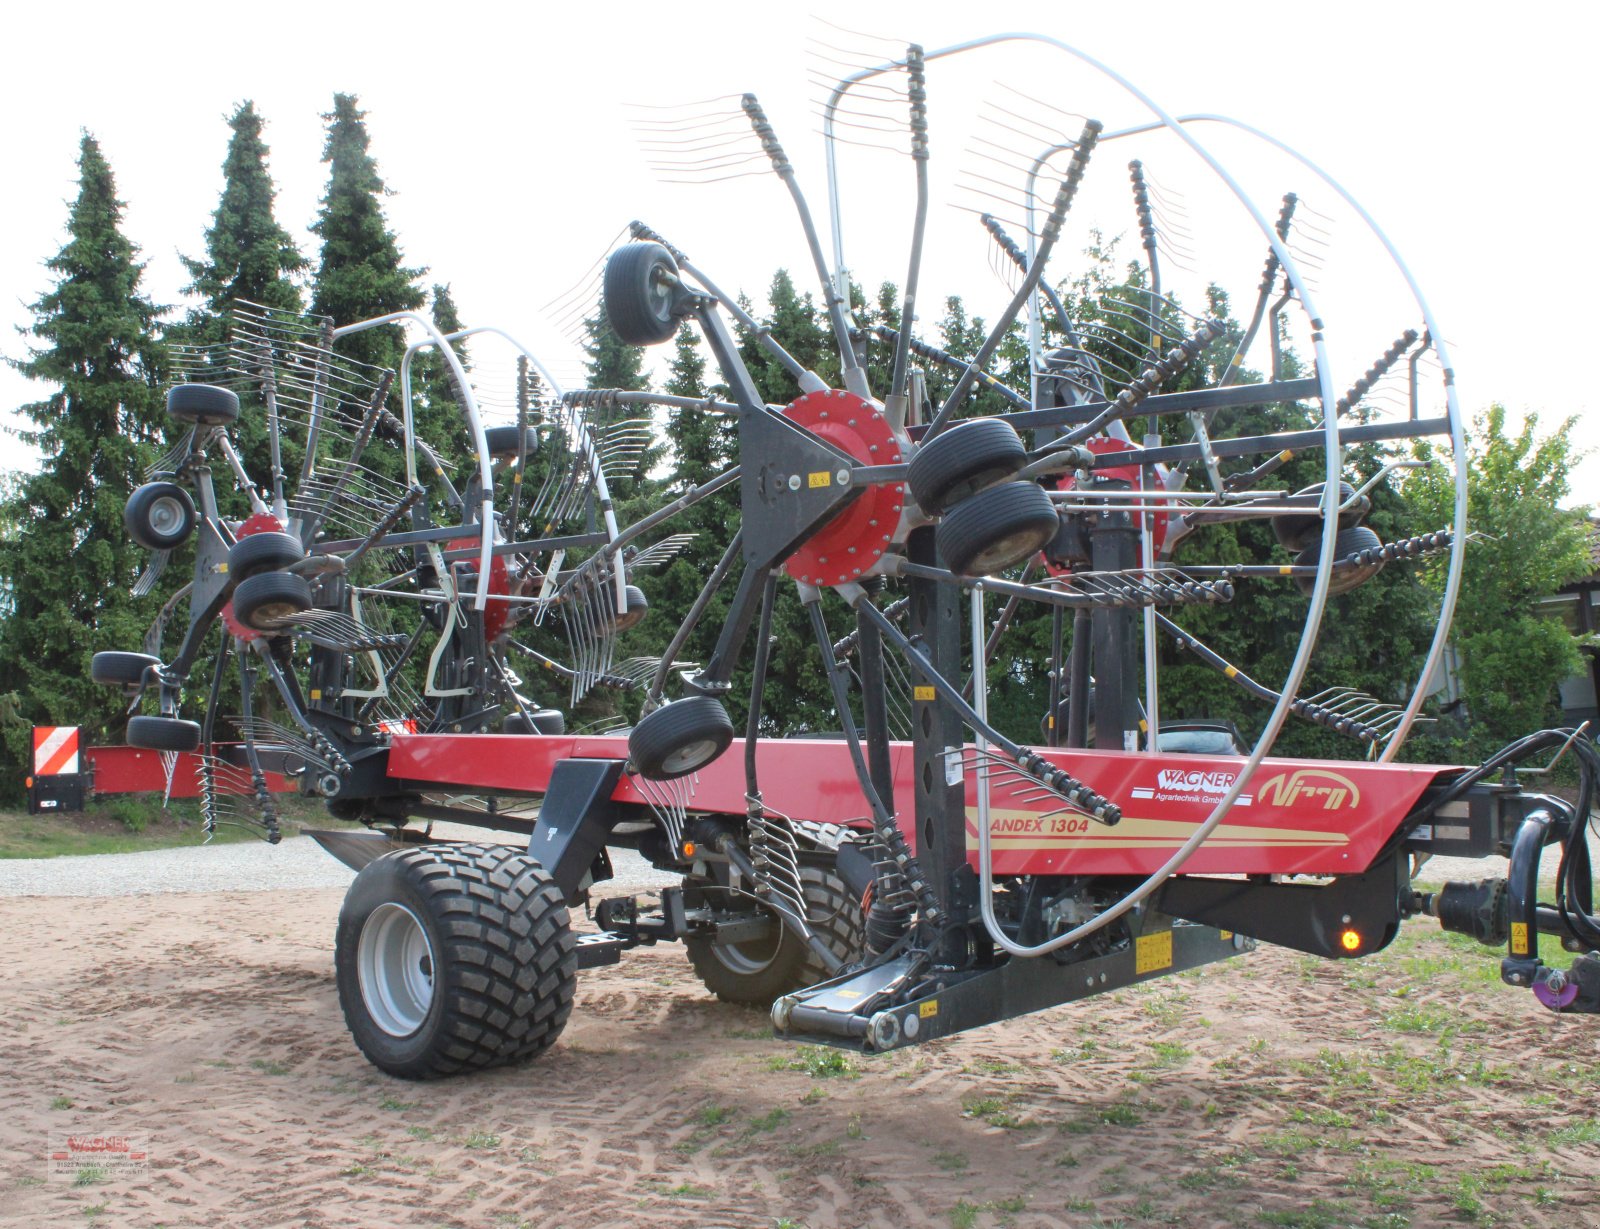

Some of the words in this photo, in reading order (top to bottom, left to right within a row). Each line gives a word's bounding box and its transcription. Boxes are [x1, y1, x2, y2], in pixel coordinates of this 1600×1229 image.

[1159, 769, 1236, 793] WAGNER
[1155, 793, 1200, 803] Agrartechnik
[991, 819, 1043, 832] ANDEX
[1051, 820, 1089, 833] 1304
